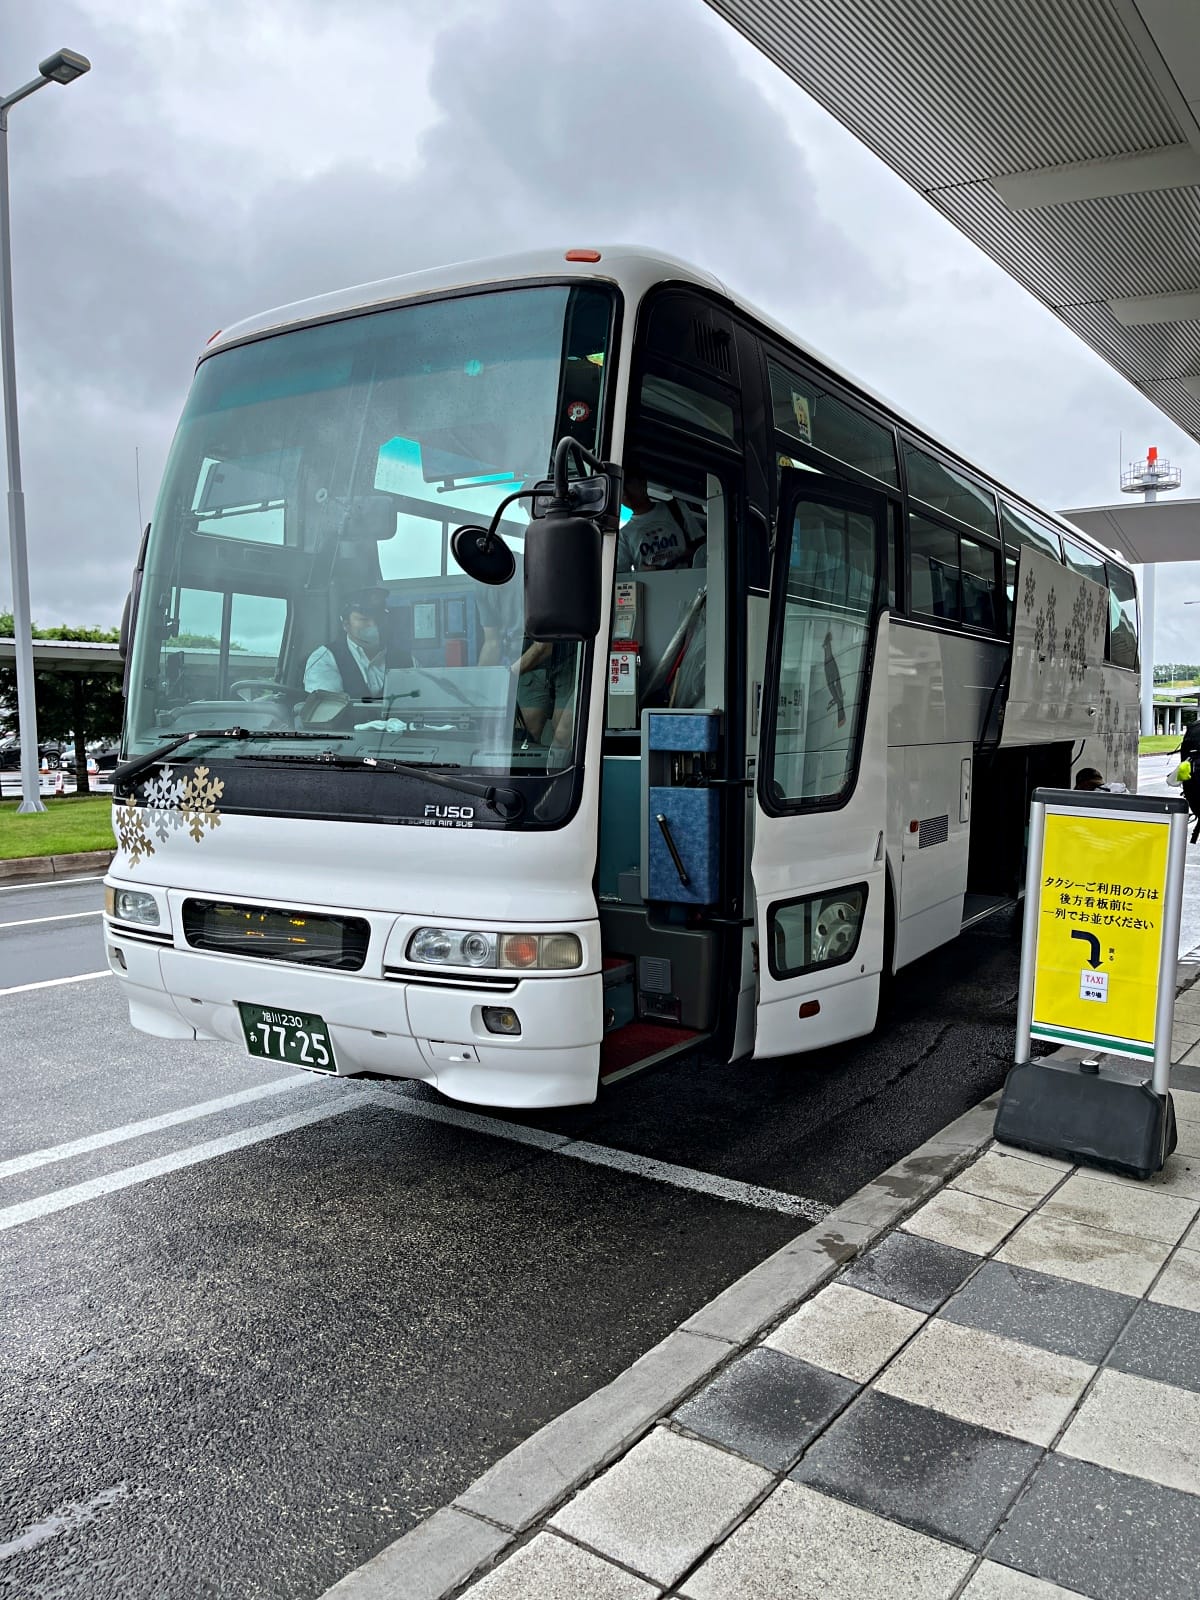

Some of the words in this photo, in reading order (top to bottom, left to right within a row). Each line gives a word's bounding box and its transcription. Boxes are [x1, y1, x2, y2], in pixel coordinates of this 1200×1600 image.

[424, 804, 474, 819] FUSO
[1044, 877, 1159, 900] タクシーご利用の方は
[1060, 893, 1134, 912] 後方看板前に
[1042, 908, 1154, 930] 一列でお並びください
[1085, 974, 1104, 985] TAXI
